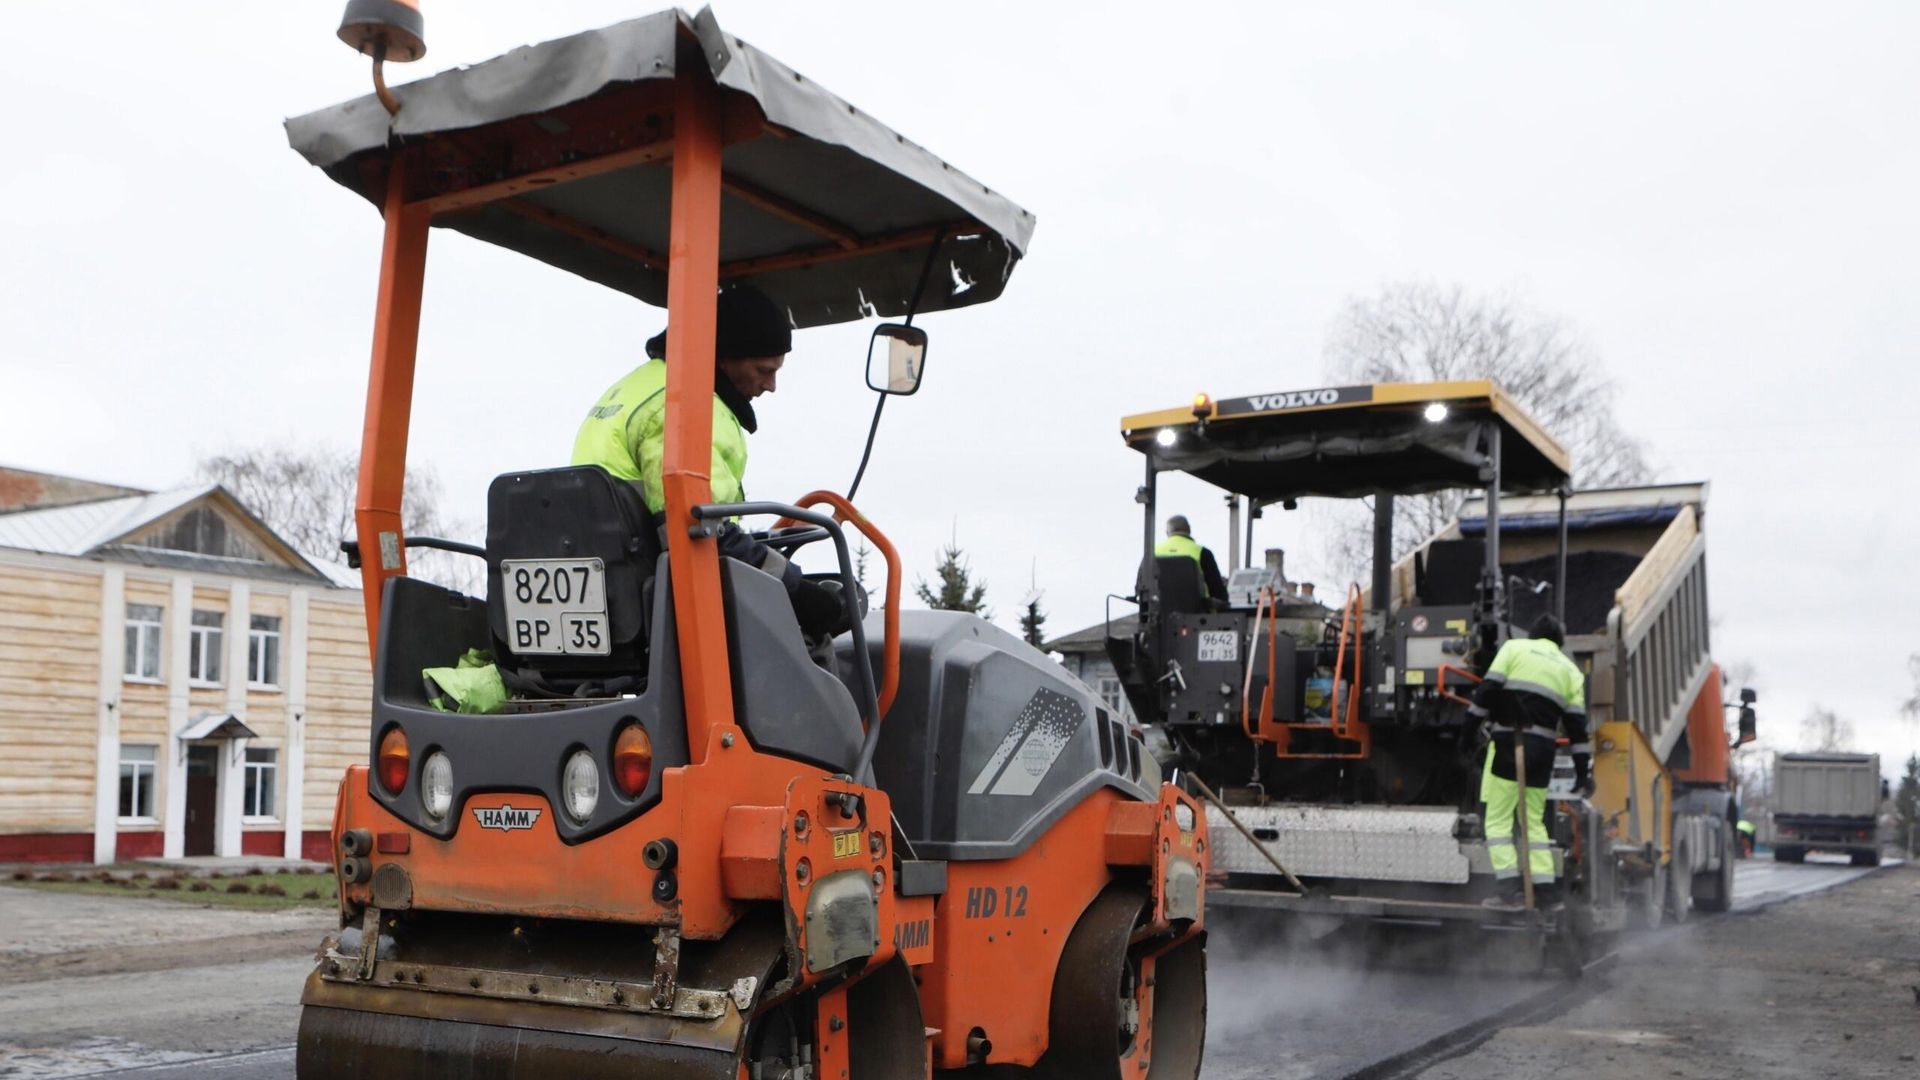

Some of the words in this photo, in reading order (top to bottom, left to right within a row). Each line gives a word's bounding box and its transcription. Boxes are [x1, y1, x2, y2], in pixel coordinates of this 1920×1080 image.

[1247, 389, 1339, 411] VOLVO
[515, 567, 590, 604] 8207
[570, 620, 600, 648] 35
[1203, 634, 1233, 646] 9642
[1224, 650, 1234, 659] 35
[484, 811, 529, 826] HAMM
[965, 887, 998, 918] HD
[1004, 886, 1029, 917] 12
